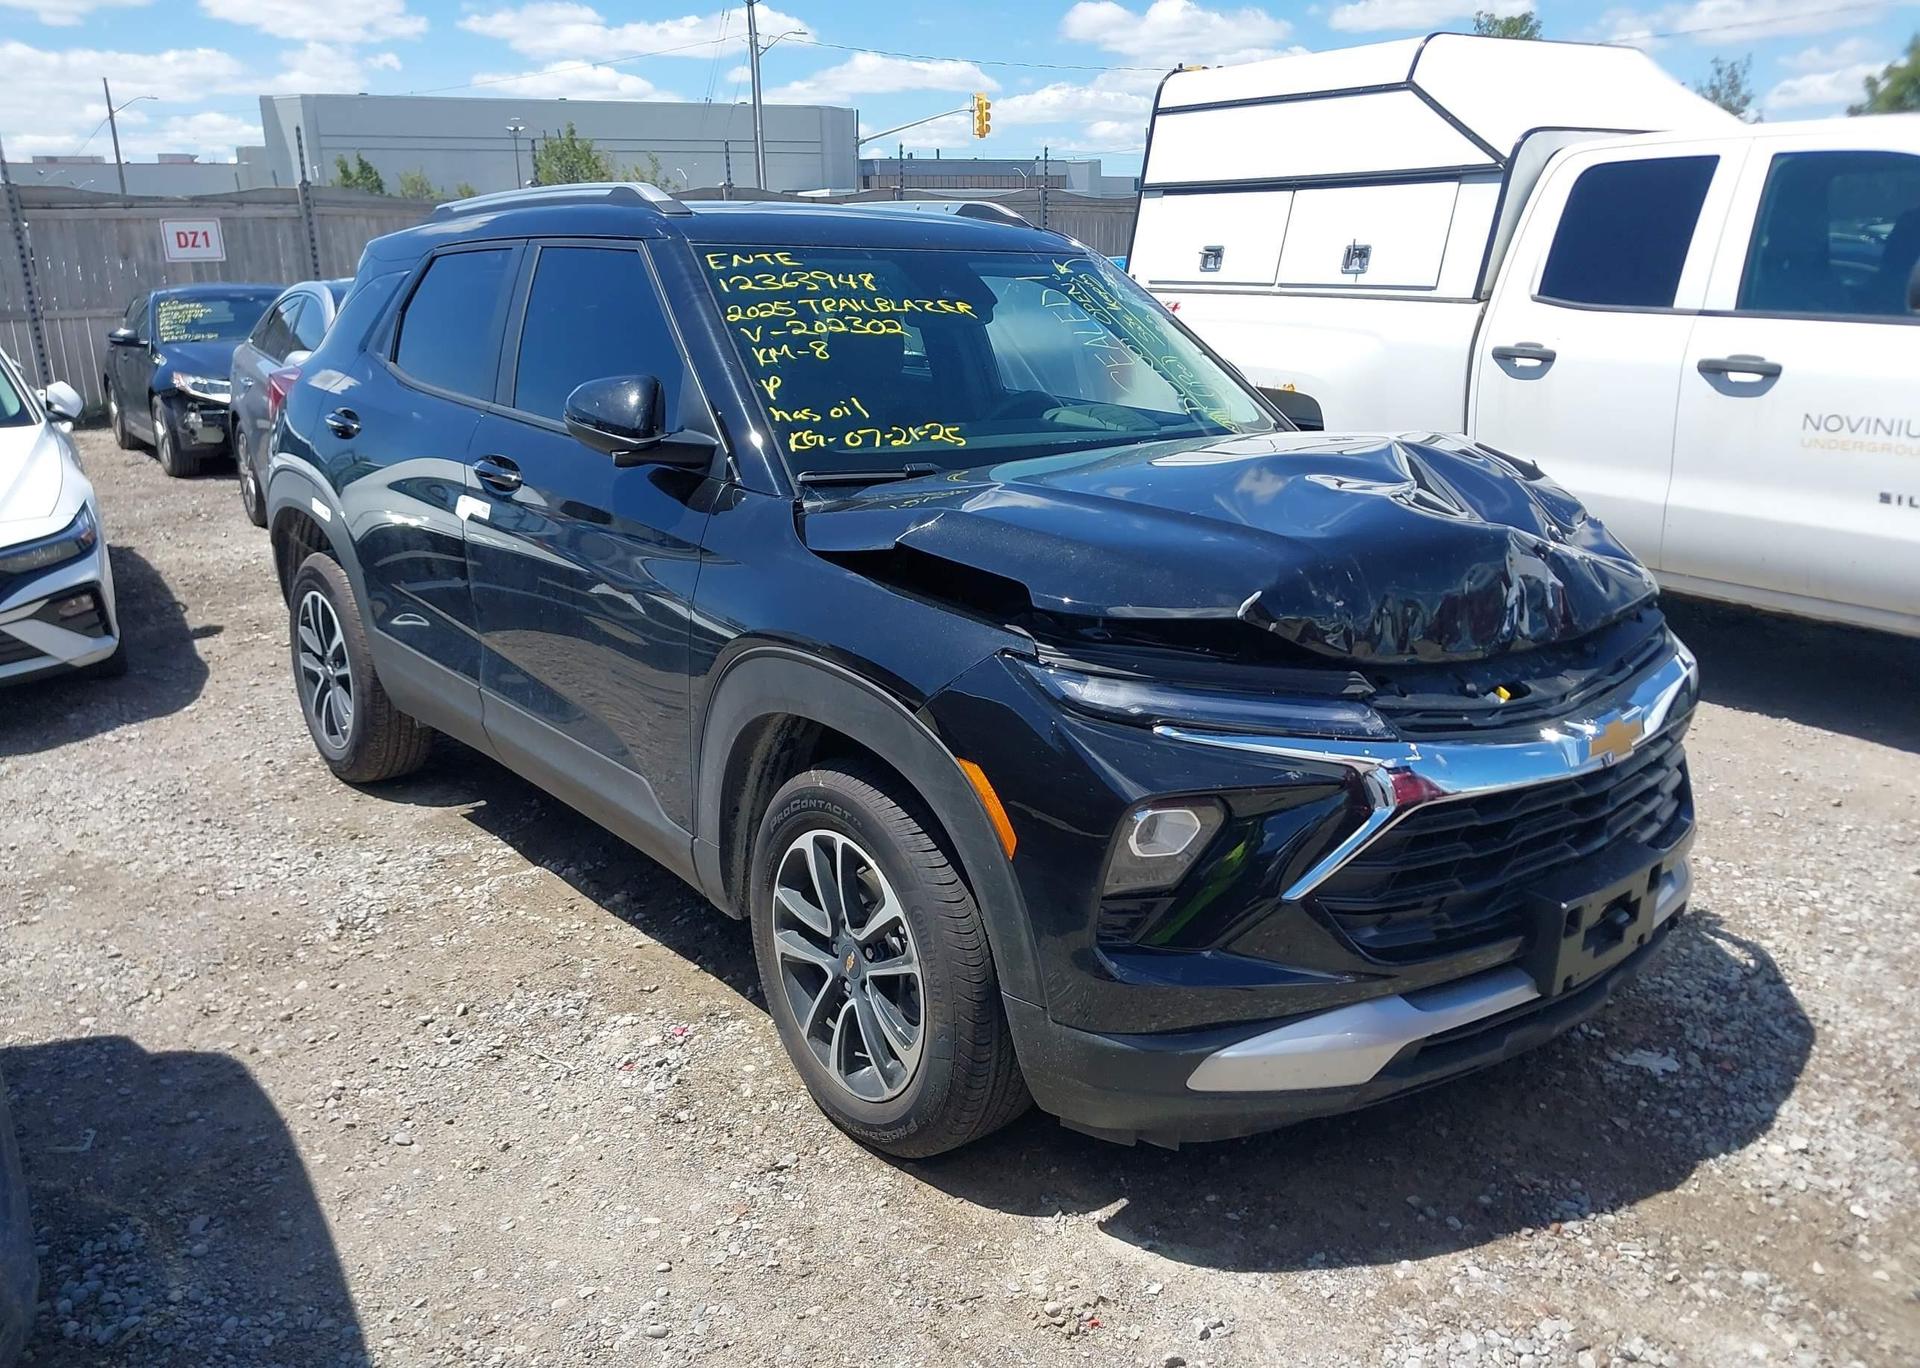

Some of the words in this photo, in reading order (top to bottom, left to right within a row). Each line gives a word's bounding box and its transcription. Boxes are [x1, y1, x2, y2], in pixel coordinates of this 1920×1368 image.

[176, 230, 210, 249] DZ1
[705, 252, 803, 270] ENTE
[719, 270, 878, 292] 12363948
[727, 300, 796, 322] 2025
[798, 297, 978, 319] TRAILBLAZER
[768, 406, 822, 422] has
[829, 396, 869, 418] oil
